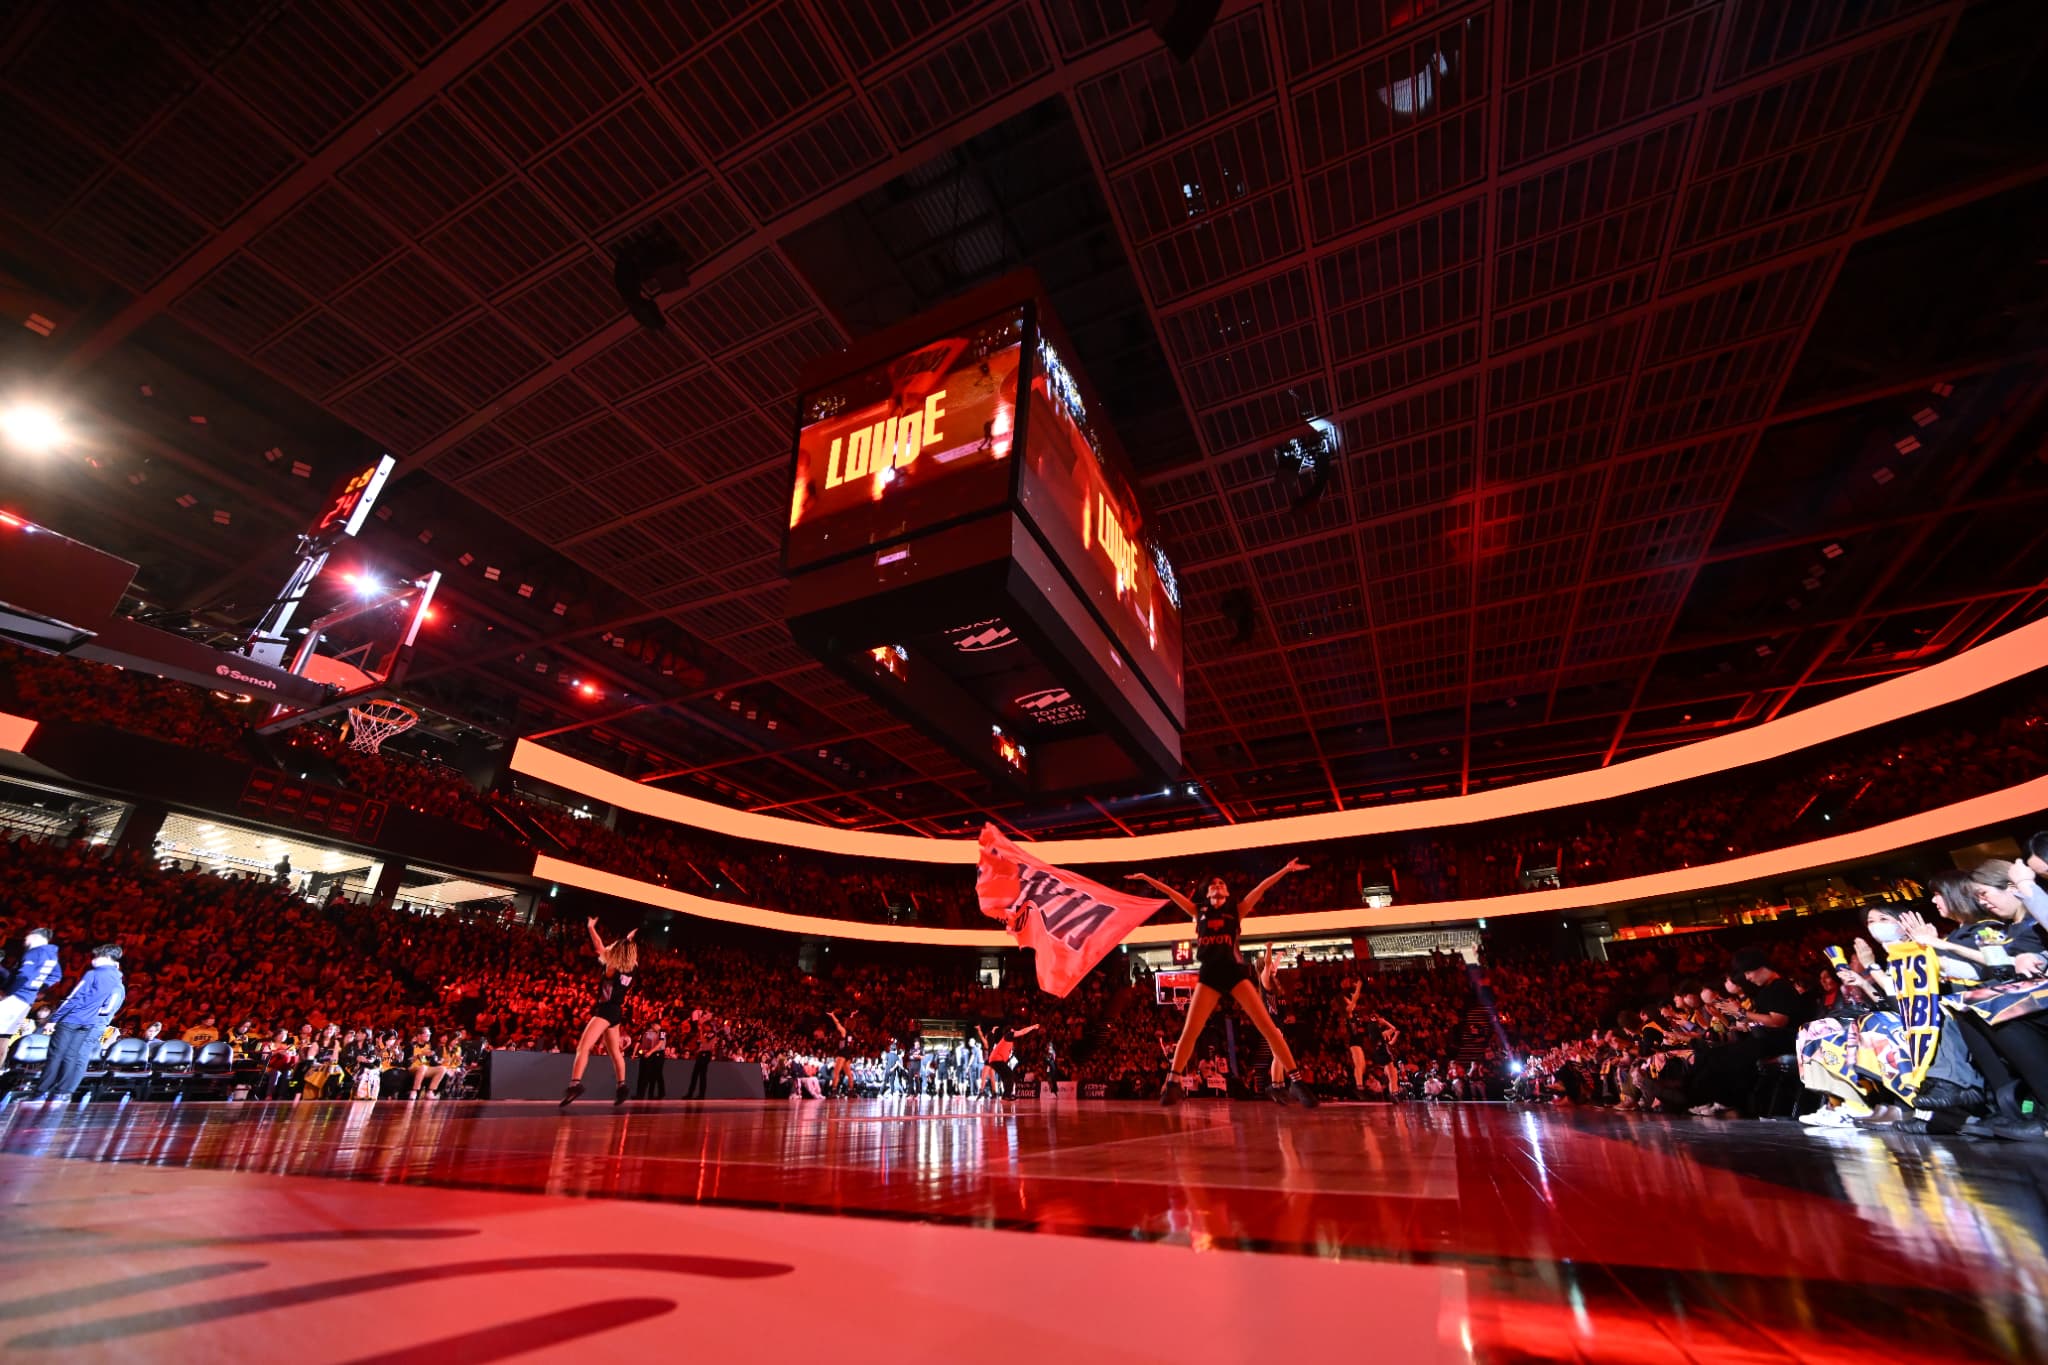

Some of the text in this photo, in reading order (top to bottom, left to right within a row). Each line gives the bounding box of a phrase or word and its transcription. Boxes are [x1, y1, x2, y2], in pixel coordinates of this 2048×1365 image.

[320, 491, 360, 529] 24
[230, 670, 277, 690] Senoh
[1176, 949, 1189, 961] 24
